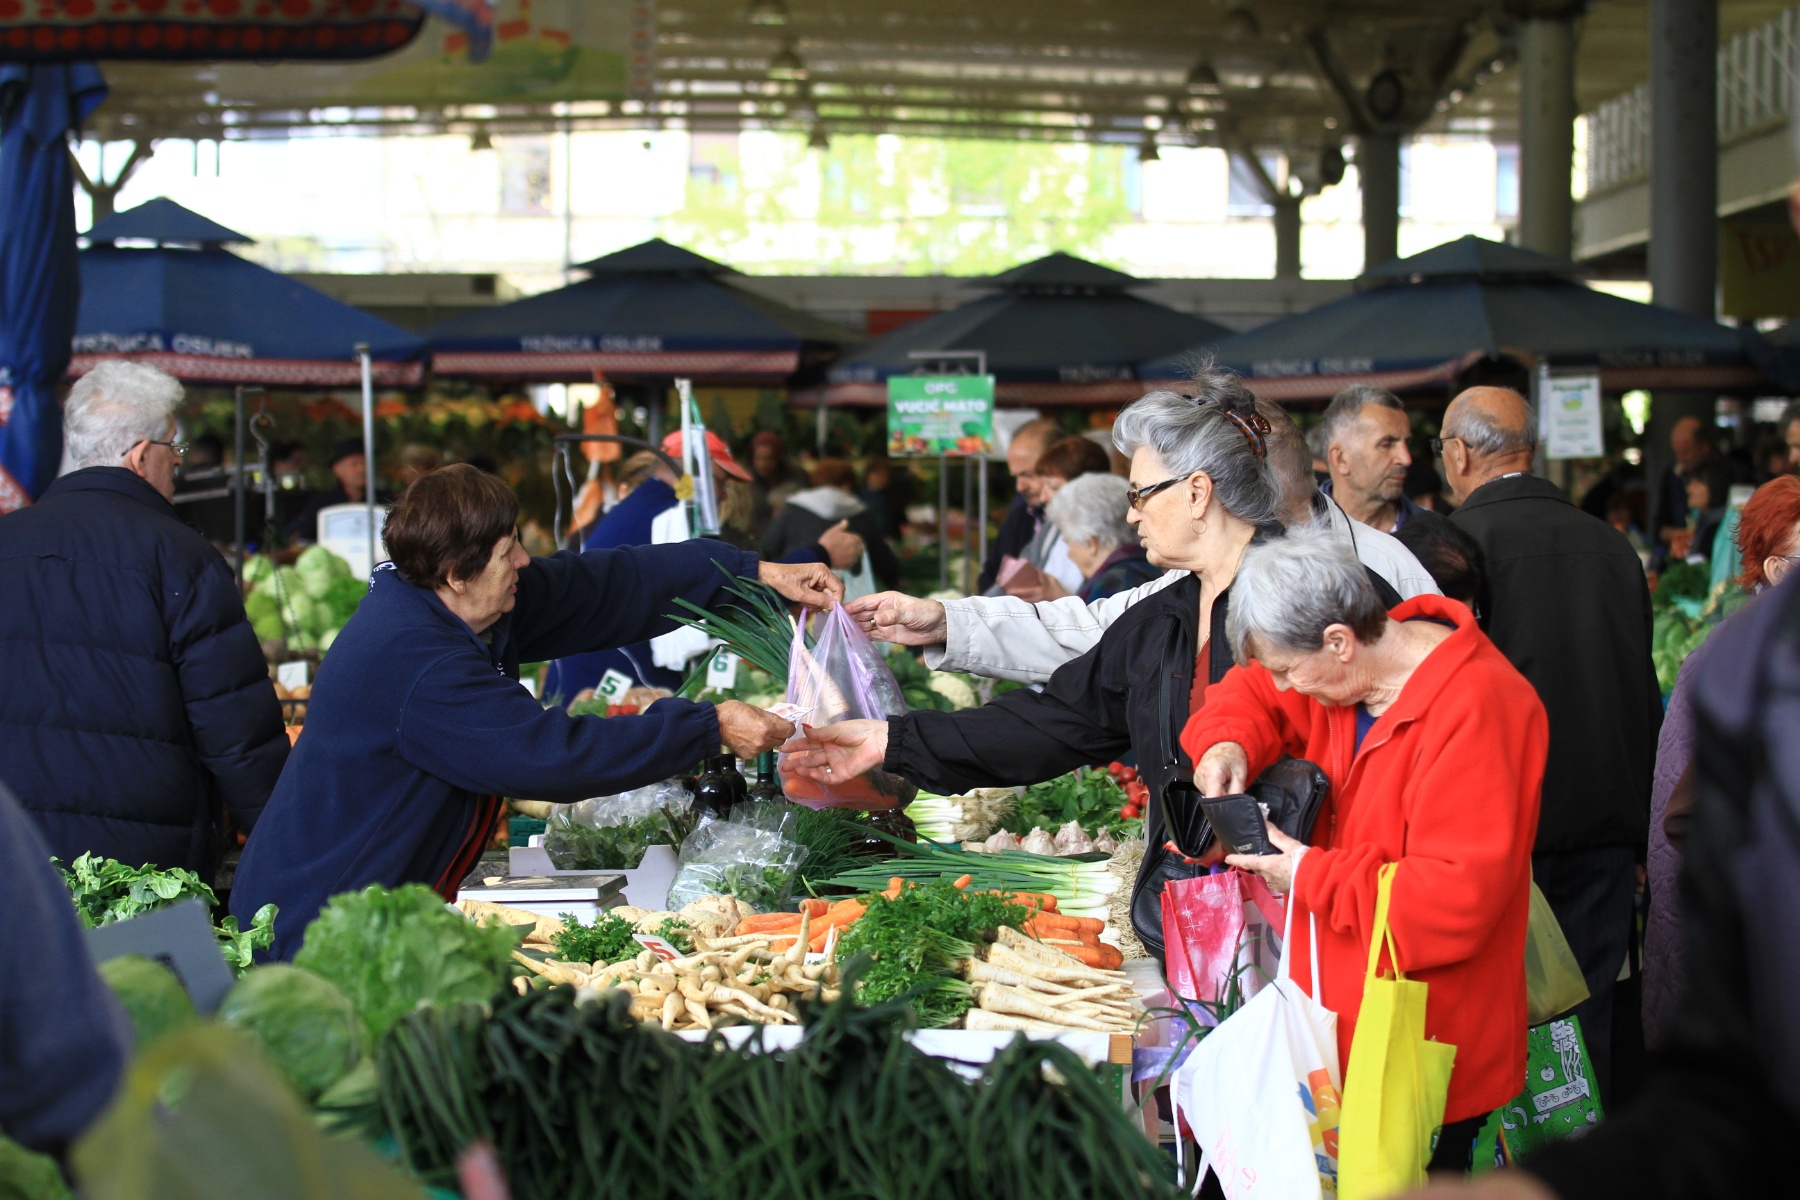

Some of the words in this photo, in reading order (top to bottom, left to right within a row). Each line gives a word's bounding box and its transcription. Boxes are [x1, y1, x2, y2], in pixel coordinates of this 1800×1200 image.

[924, 381, 958, 395] OPG
[943, 399, 988, 413] MATO
[712, 652, 729, 673] 6
[600, 675, 622, 696] 5
[641, 941, 677, 961] 5
